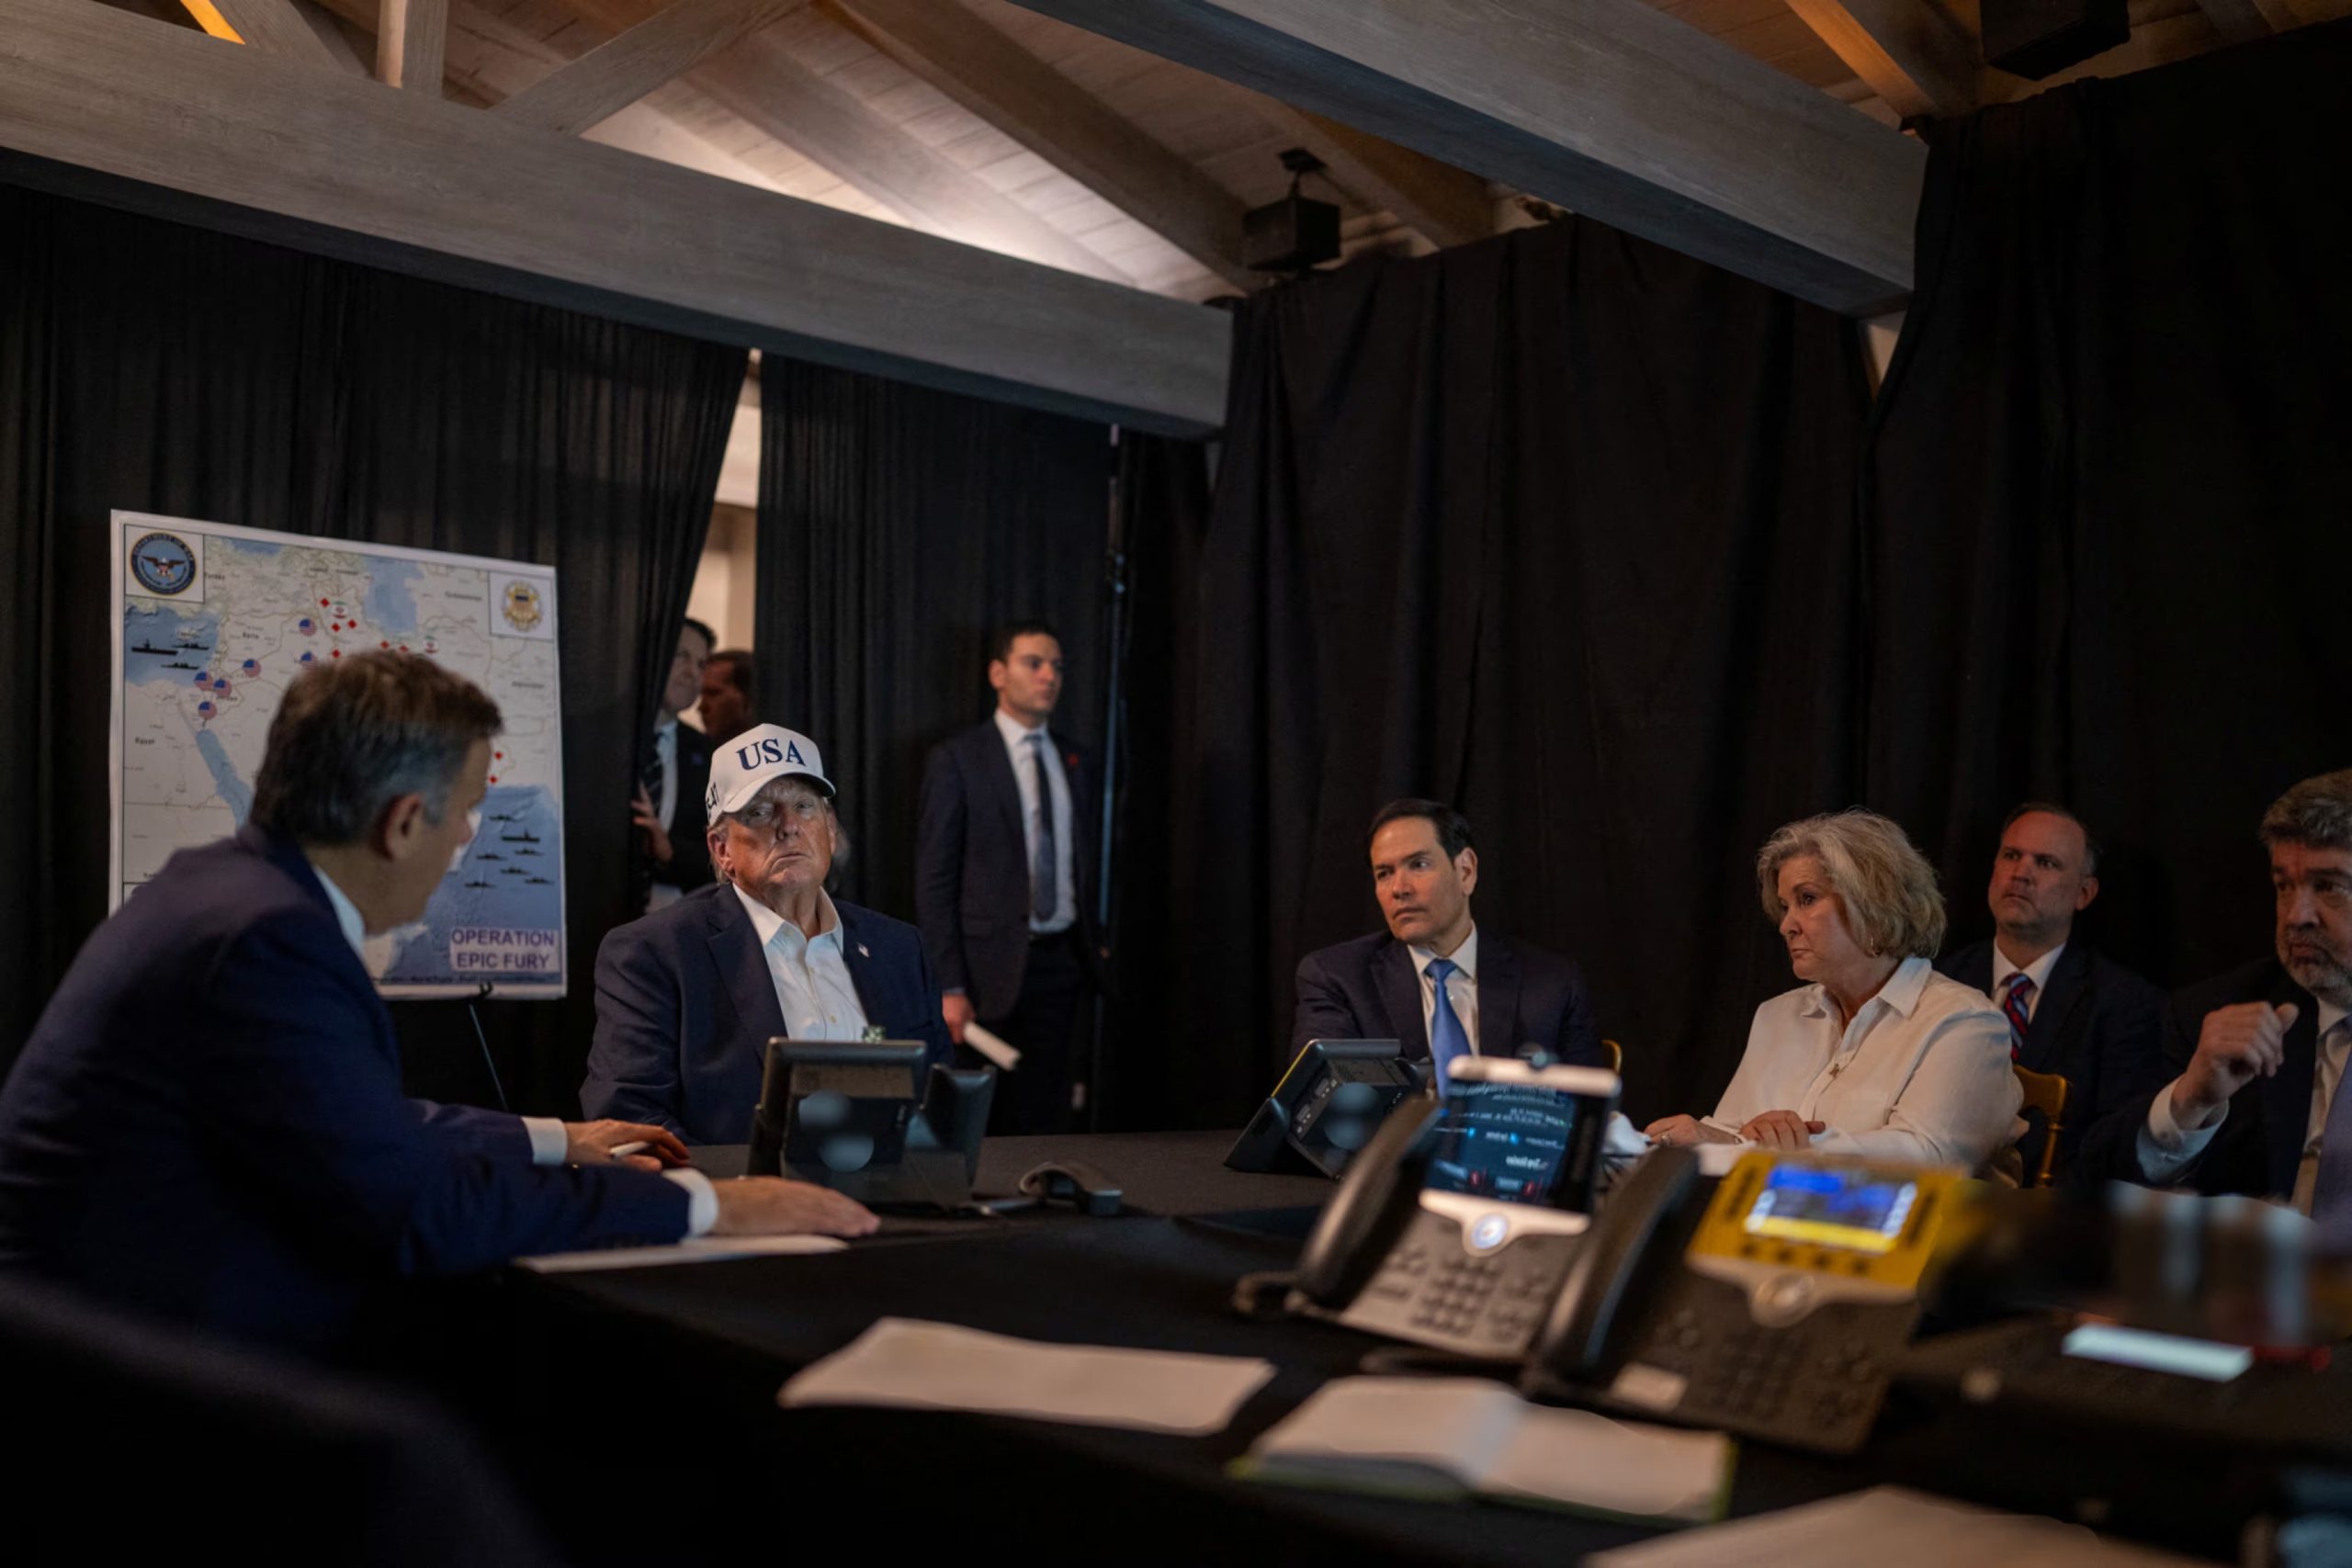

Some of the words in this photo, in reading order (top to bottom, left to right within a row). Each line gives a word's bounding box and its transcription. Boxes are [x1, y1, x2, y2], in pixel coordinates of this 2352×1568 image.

[736, 739, 807, 771] USA
[451, 928, 554, 946] OPERATION
[457, 953, 497, 968] EPIC
[503, 953, 549, 969] FURY
